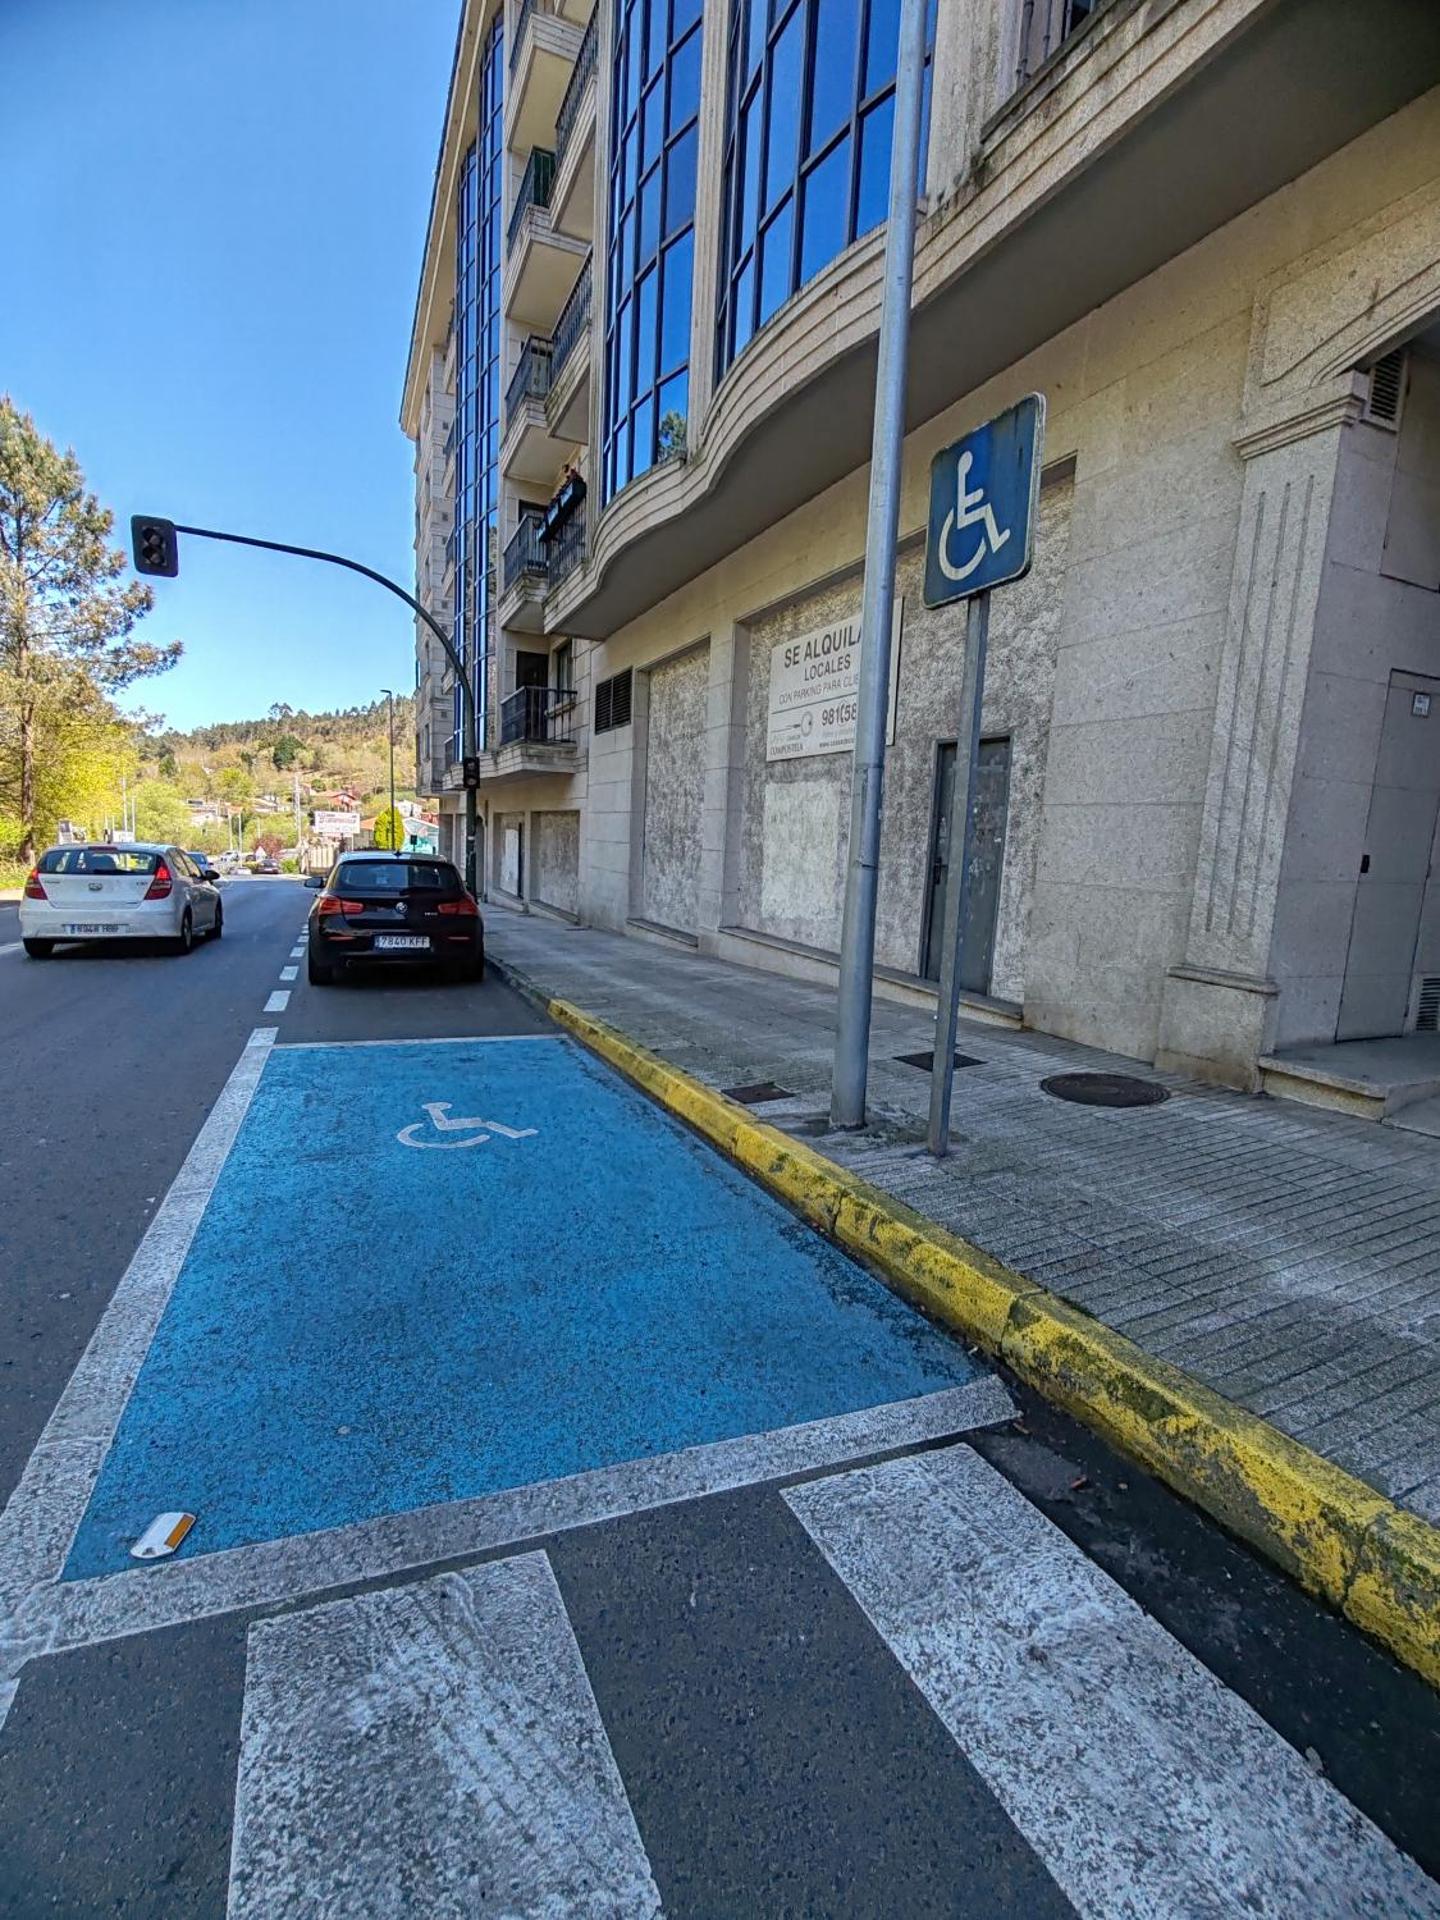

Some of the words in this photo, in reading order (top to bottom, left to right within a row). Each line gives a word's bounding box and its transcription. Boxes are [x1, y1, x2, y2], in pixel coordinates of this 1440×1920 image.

[784, 644, 801, 668] SE
[804, 653, 851, 681] LOCALES
[792, 683, 822, 700] PARKING
[823, 678, 842, 692] PARA
